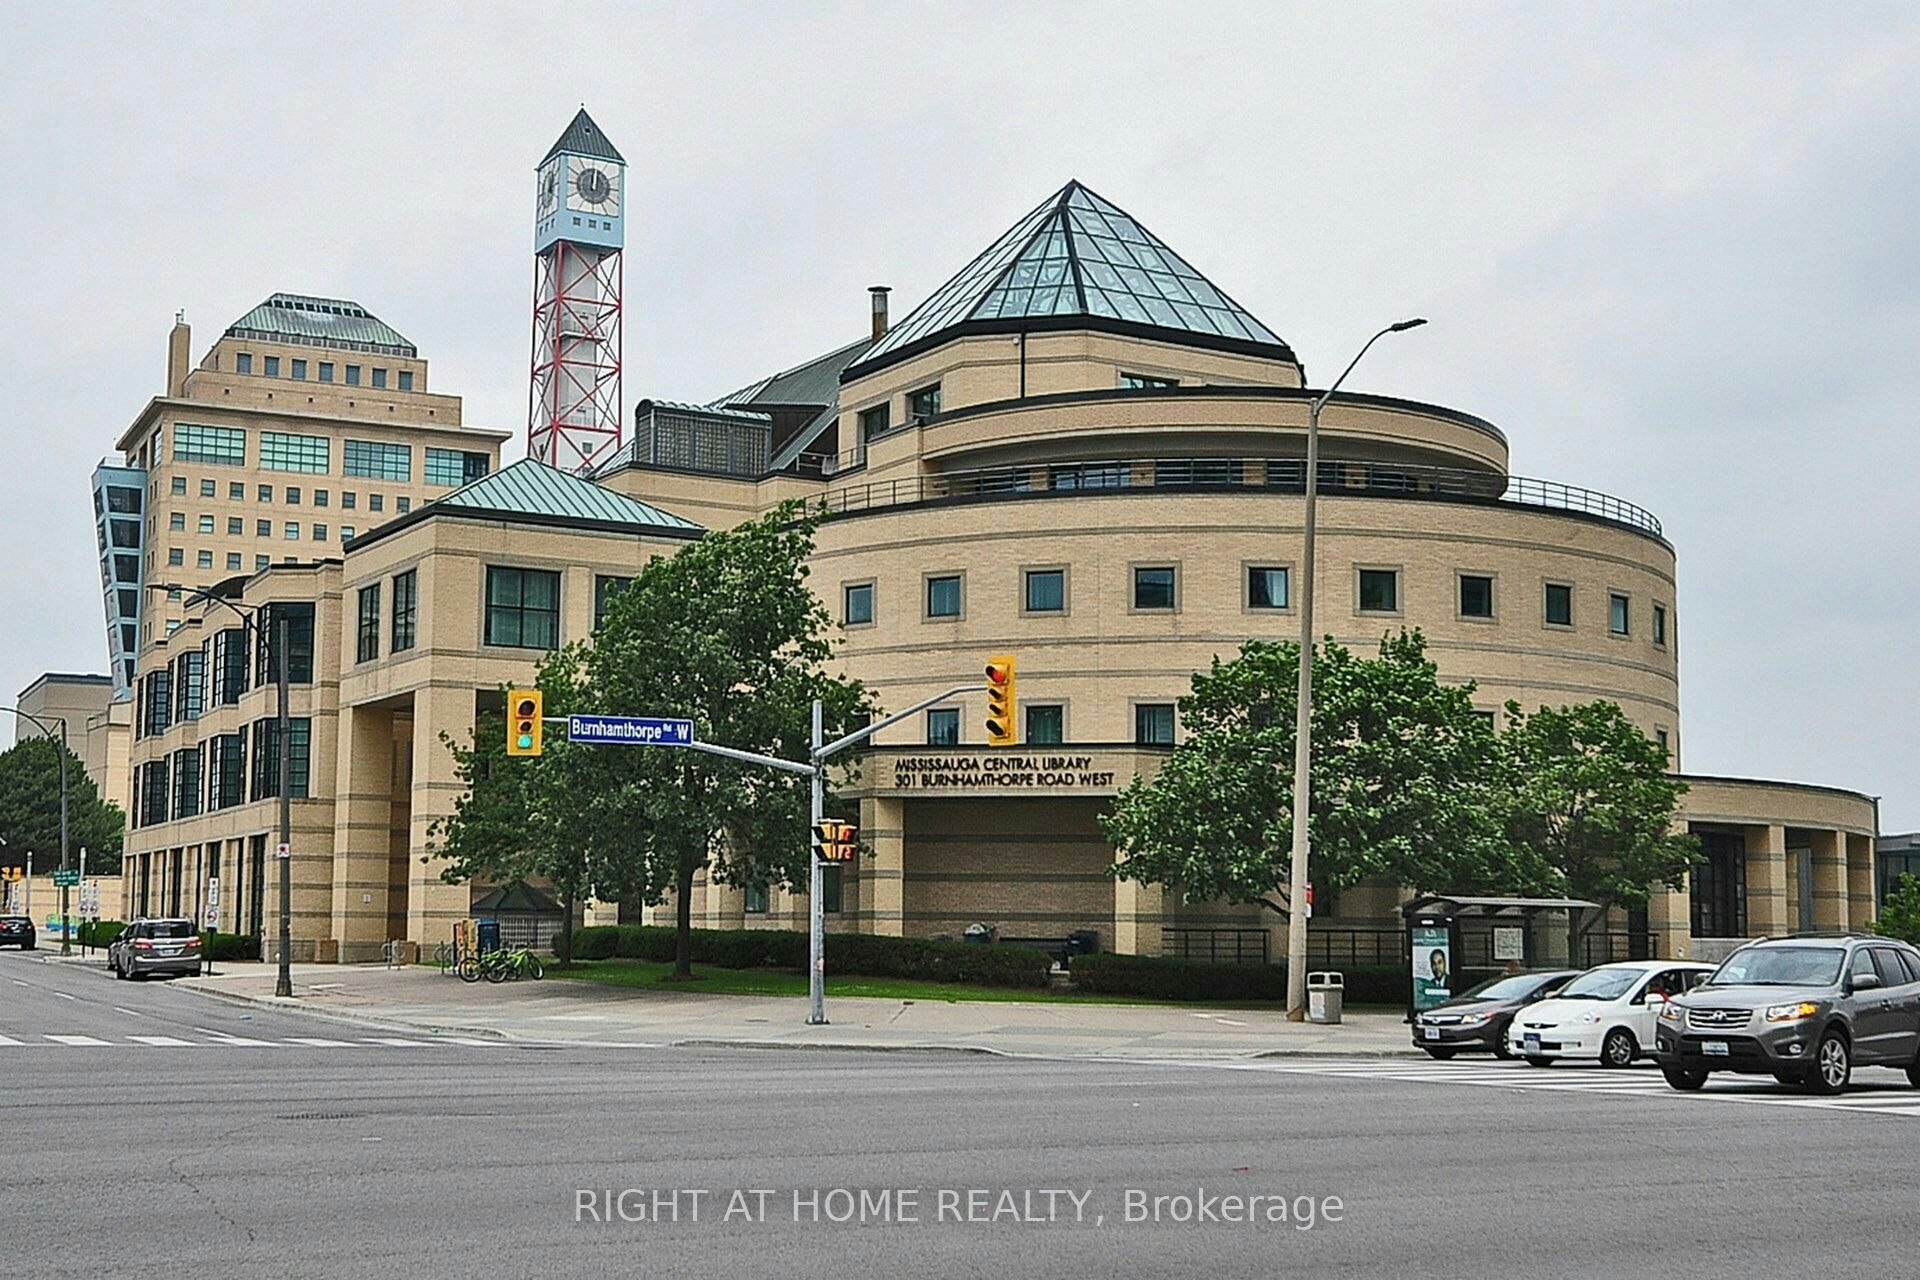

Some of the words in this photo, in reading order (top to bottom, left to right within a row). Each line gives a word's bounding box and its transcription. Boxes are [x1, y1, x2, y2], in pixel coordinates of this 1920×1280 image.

[572, 719, 662, 741] Burnhamthorpe
[677, 724, 689, 740] W
[895, 757, 980, 772] MISSISSAUGA
[983, 757, 1039, 771] CENTRAL
[1042, 757, 1092, 771] LIBRARY
[895, 773, 917, 787] 301
[921, 773, 1034, 787] BURNHAMTHORPE
[1037, 773, 1075, 786] ROAD
[1079, 773, 1114, 785] WEST
